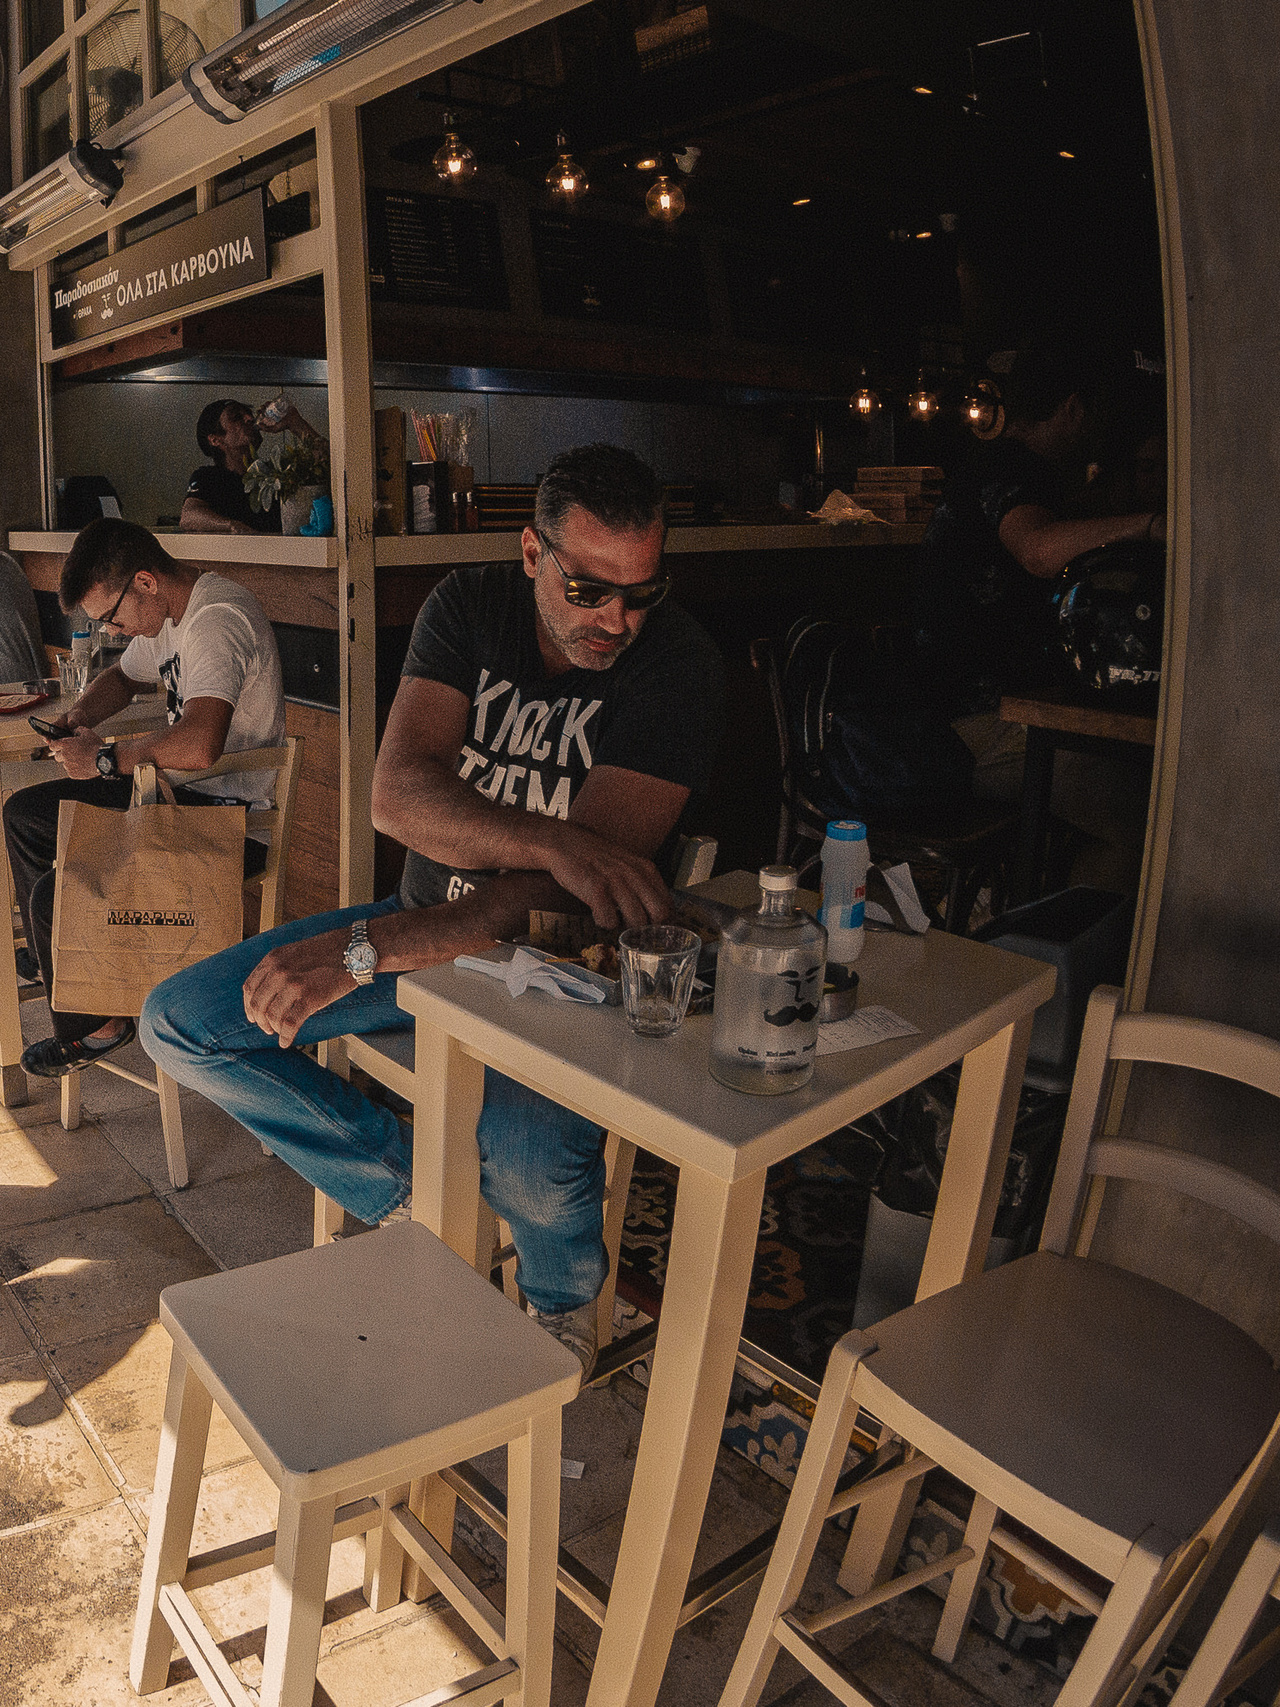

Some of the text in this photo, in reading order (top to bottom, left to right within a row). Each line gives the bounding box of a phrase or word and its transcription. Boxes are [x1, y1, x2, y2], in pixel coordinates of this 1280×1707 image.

[116, 236, 254, 307] ΟΛΑ ΣΤΑ ΚΑΡΒΟΥΝΑ
[110, 911, 193, 925] NAPAPIJRI
